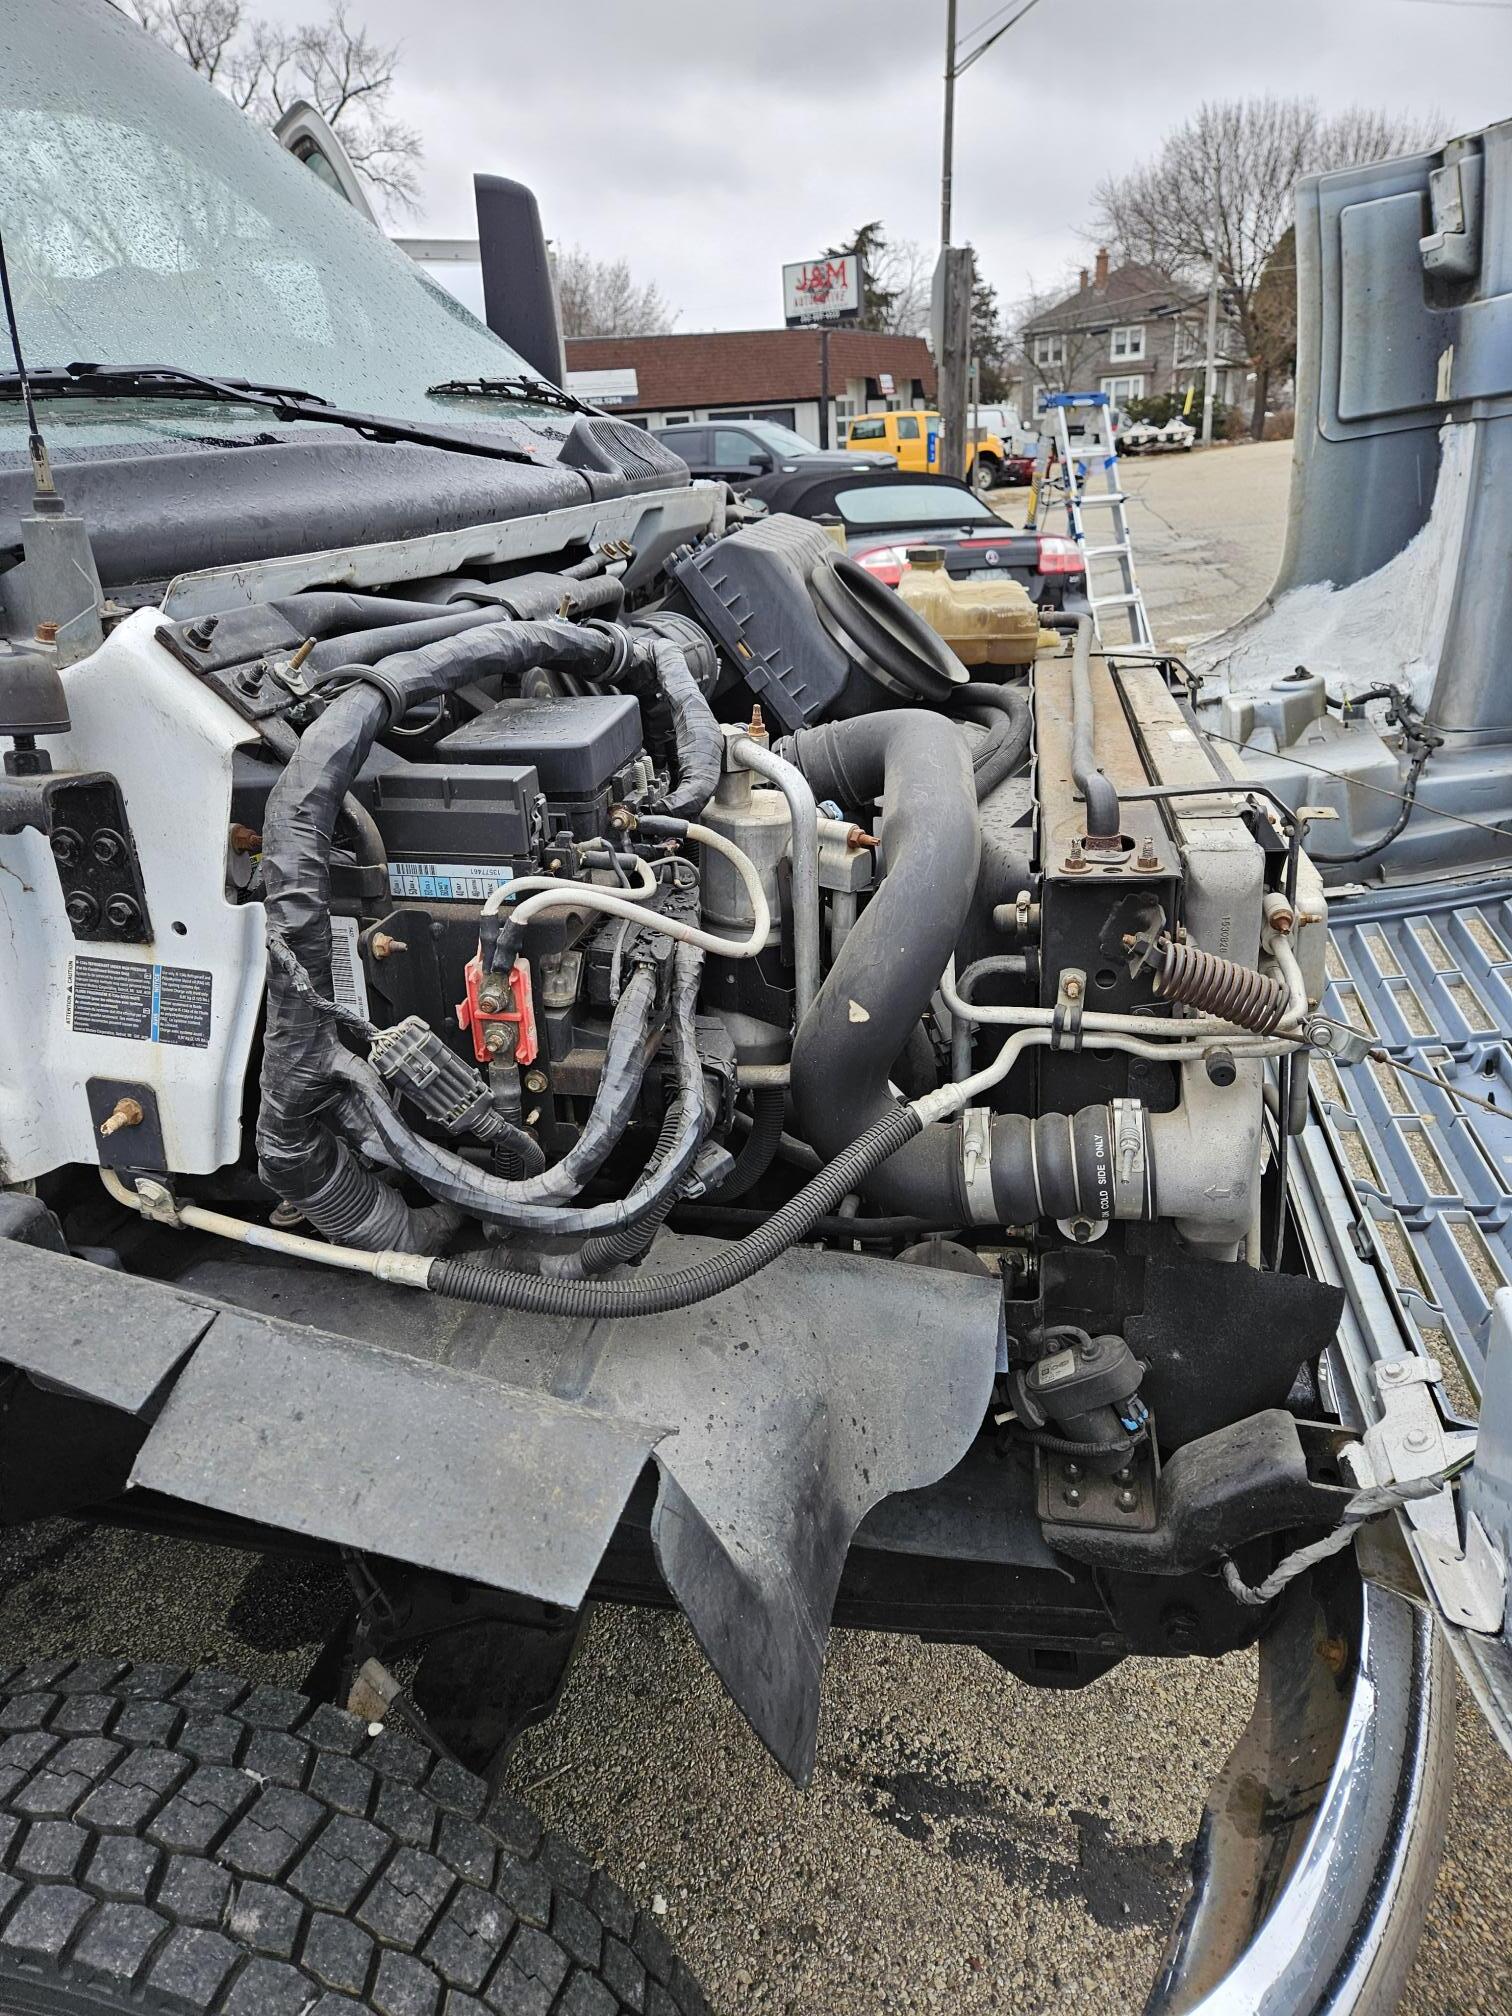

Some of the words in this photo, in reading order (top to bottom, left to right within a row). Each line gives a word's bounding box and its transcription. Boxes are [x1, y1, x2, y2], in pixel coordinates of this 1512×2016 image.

[795, 260, 848, 291] J&M
[794, 289, 846, 307] AUTOTIVE
[1094, 1134, 1104, 1158] ONLY
[1097, 1164, 1107, 1185] SIDE
[1100, 1190, 1109, 1210] COLD
